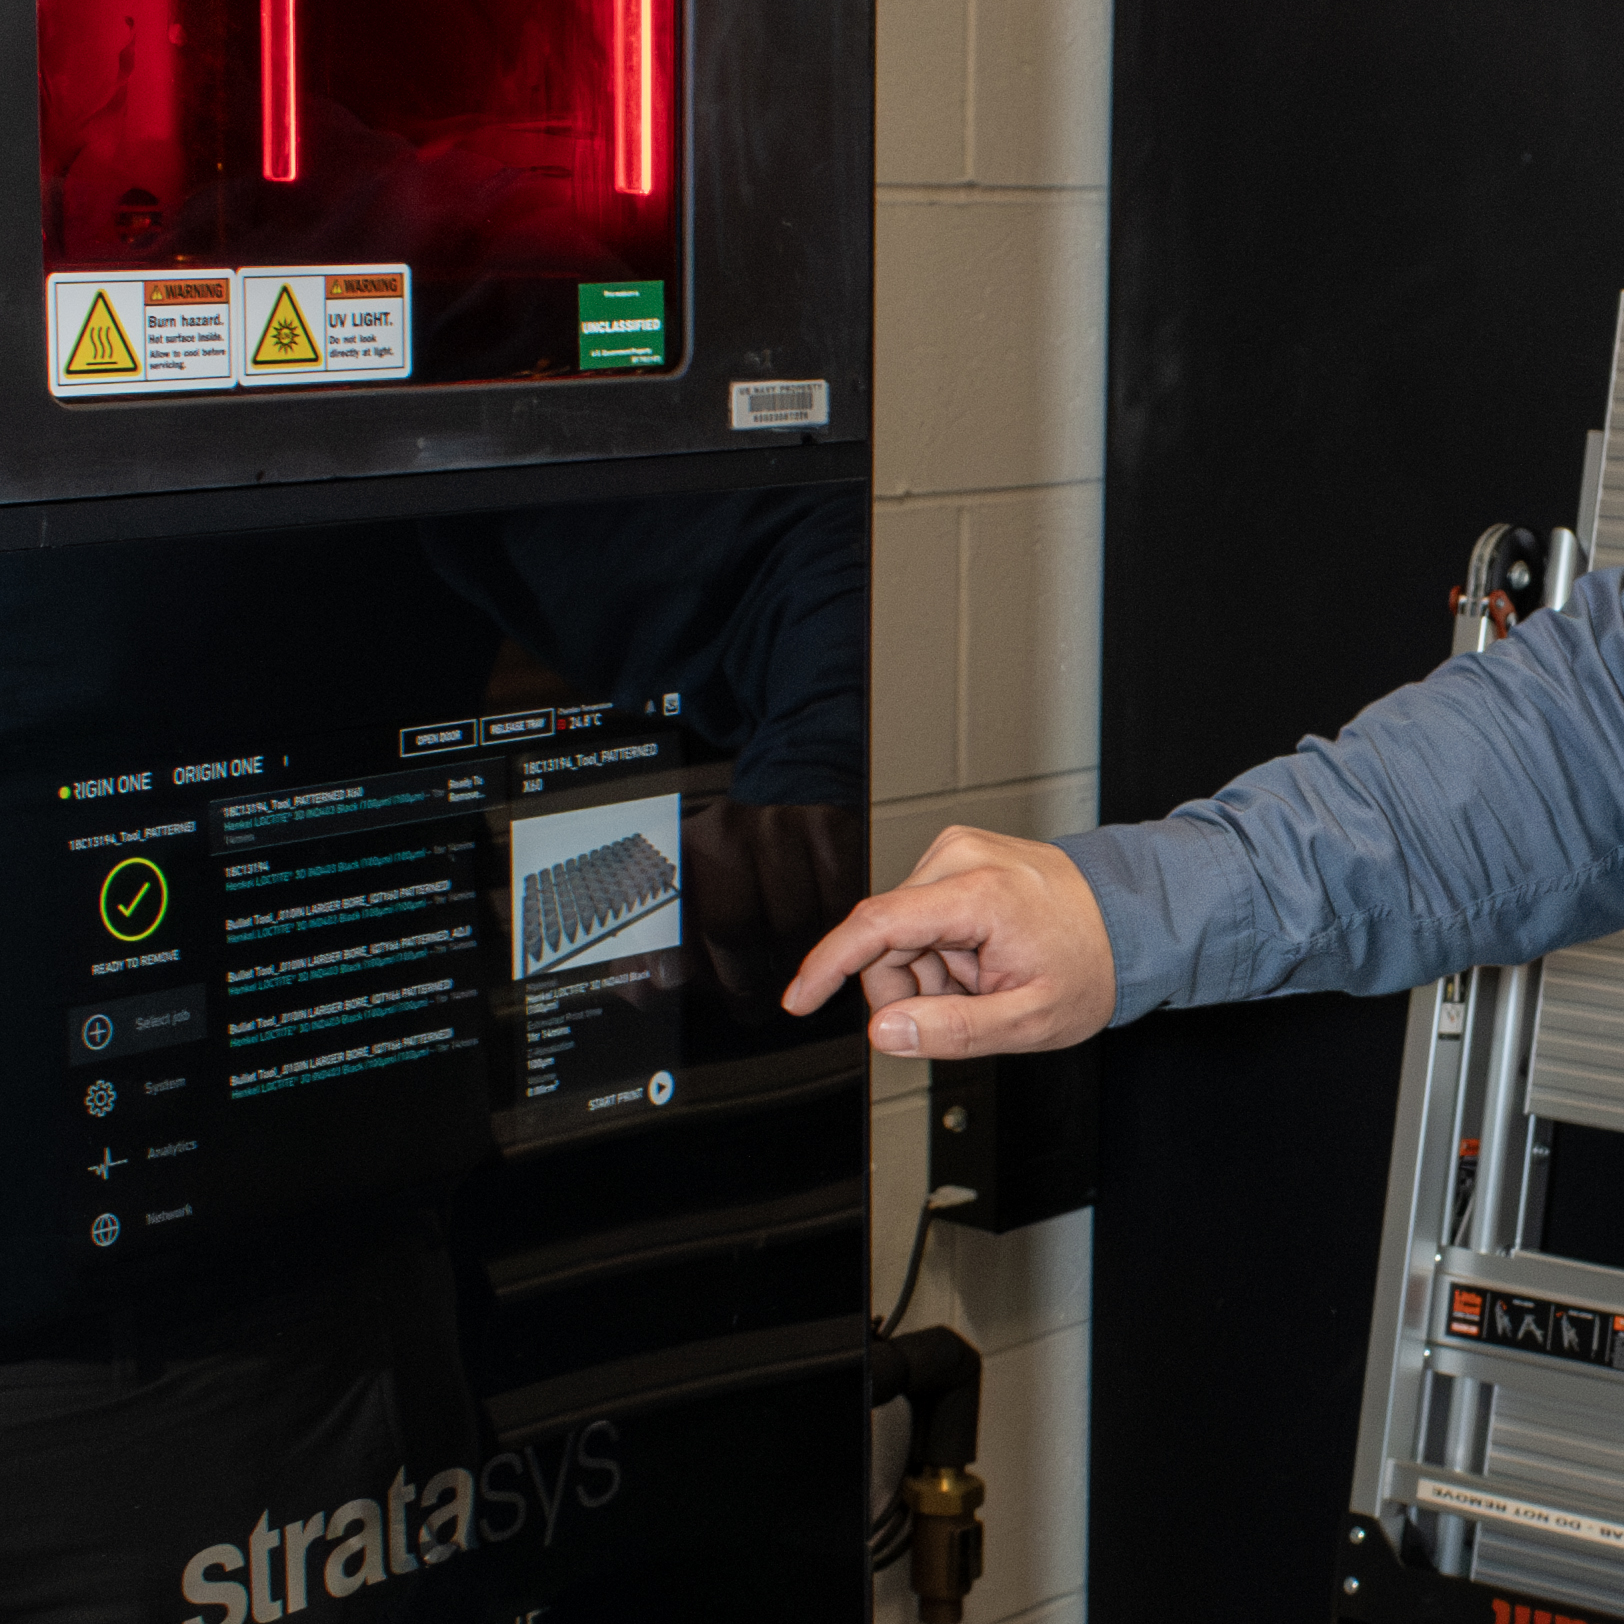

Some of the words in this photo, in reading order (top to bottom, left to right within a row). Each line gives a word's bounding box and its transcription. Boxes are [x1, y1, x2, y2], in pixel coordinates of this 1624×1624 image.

[164, 283, 223, 299] WARNING
[344, 278, 397, 293] WARNING
[148, 315, 177, 328] Burn
[180, 313, 224, 327] hazard.
[328, 313, 347, 329] UV
[351, 311, 394, 328] LIGHT.
[581, 318, 661, 334] UNCLASSIFIED
[148, 334, 164, 344] Hot
[165, 333, 195, 343] surface
[328, 335, 341, 345] Do
[343, 335, 357, 344] not
[359, 334, 377, 343] look
[149, 349, 170, 358] Allow
[183, 348, 200, 357] cool
[201, 347, 226, 356] before
[329, 348, 359, 358] directly
[362, 348, 372, 357] at
[149, 360, 186, 370] servicing.
[415, 733, 439, 746] OPEN
[439, 729, 463, 743] DOOR
[172, 761, 228, 786] ORIGIN
[229, 755, 264, 776] ONE
[116, 772, 152, 794] ONE
[91, 960, 125, 976] READY
[125, 957, 140, 969] TO
[140, 949, 181, 966] REMOVE
[1432, 1485, 1507, 1512] REMOVE
[1514, 1506, 1549, 1524] NOT
[1555, 1516, 1581, 1531] DO
